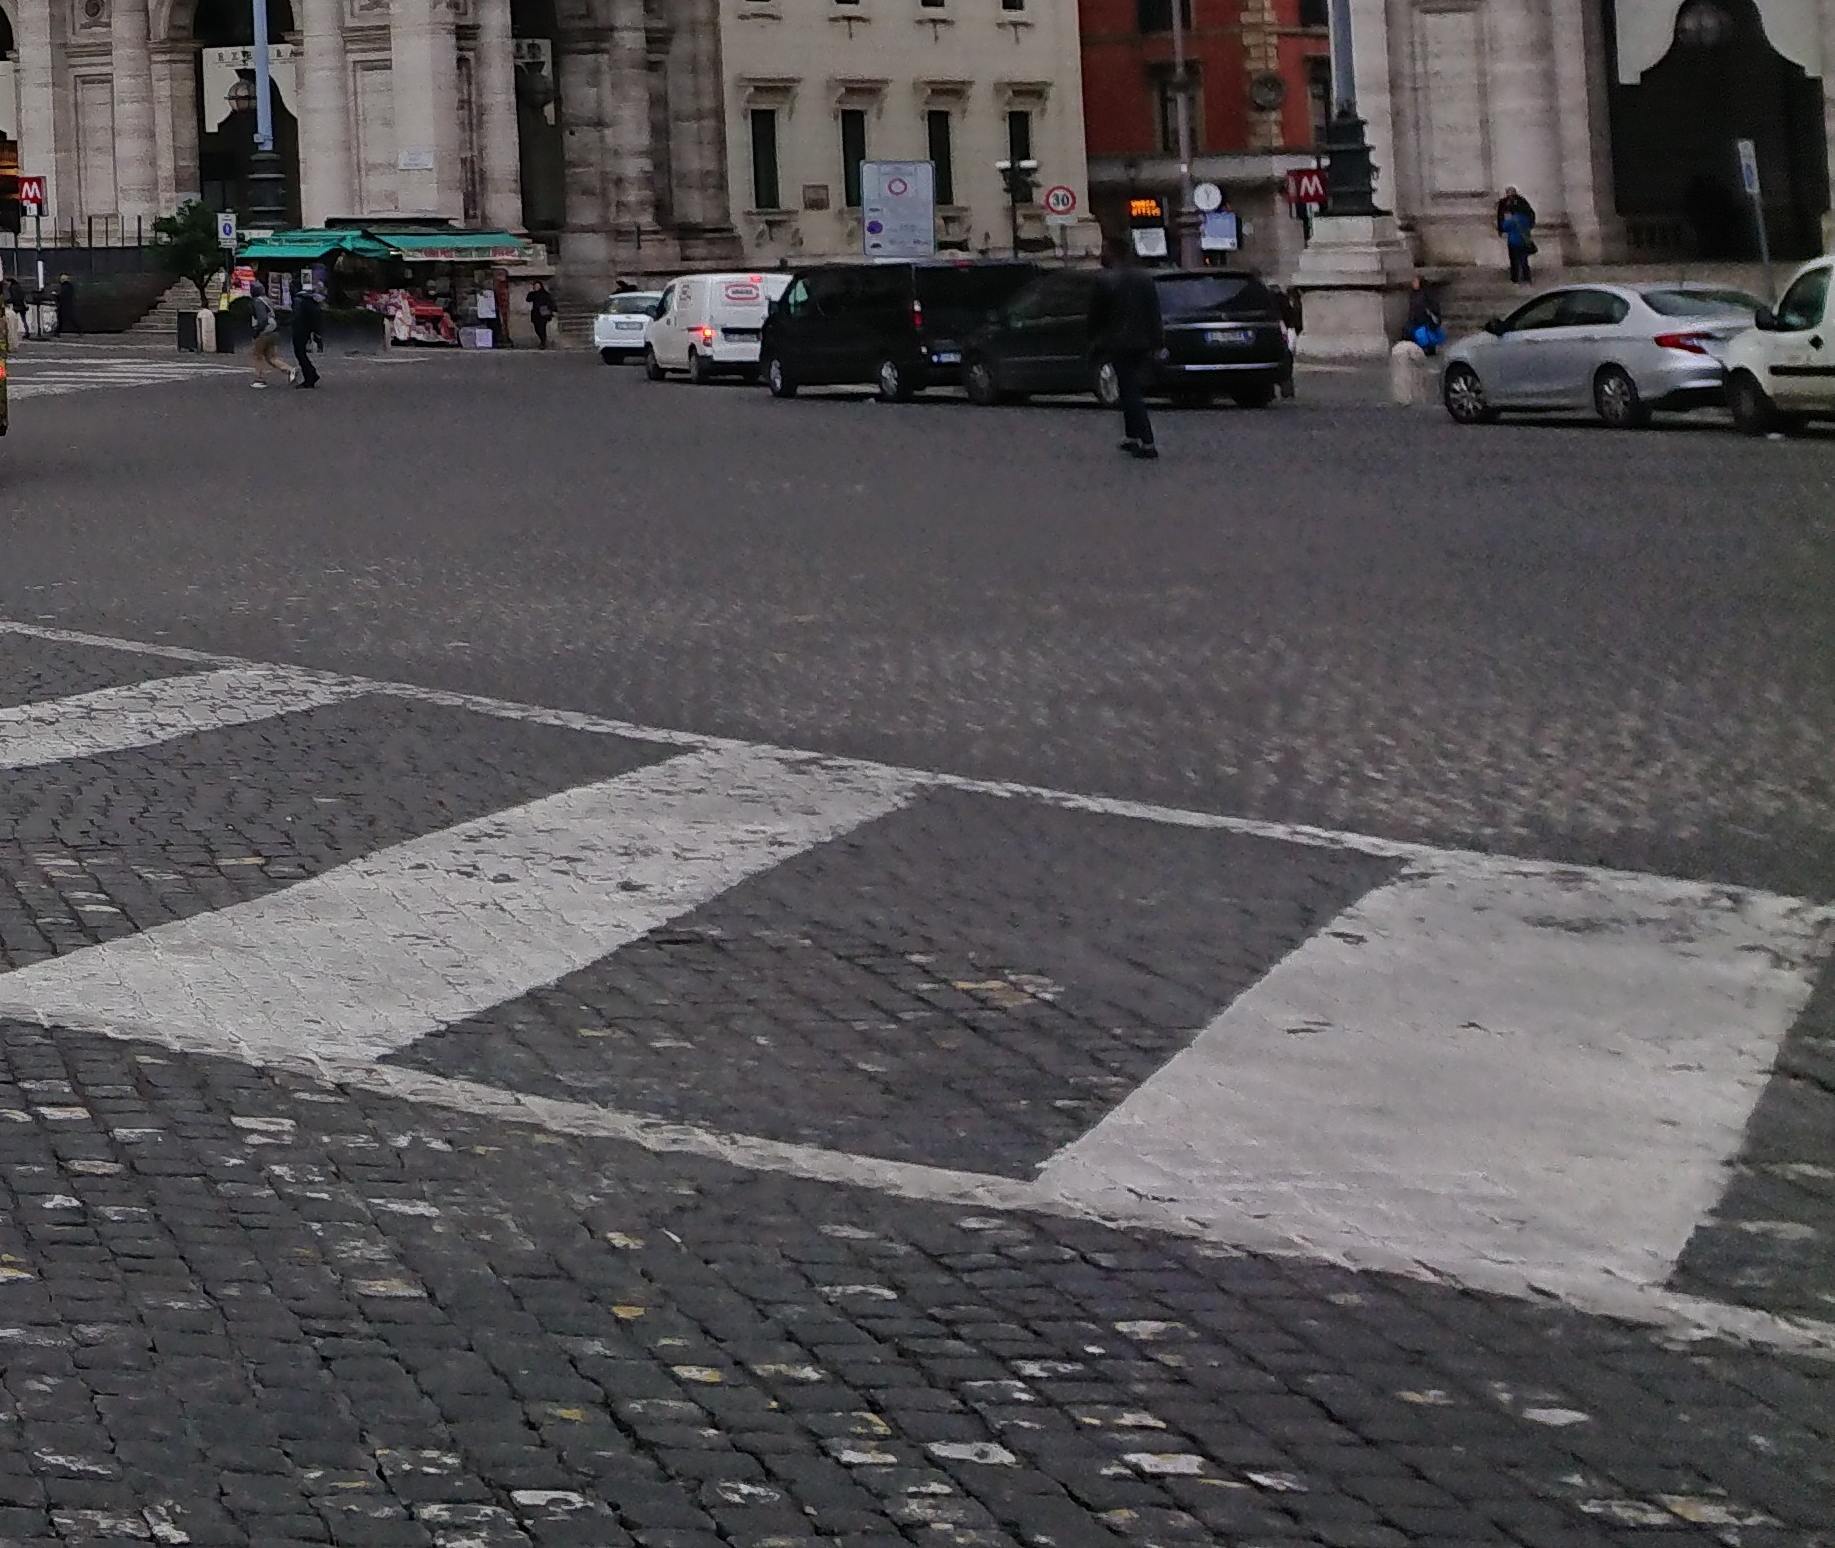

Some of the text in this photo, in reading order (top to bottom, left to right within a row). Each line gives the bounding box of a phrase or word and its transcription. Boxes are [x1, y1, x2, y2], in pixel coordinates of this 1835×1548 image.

[21, 181, 42, 199] M
[1299, 173, 1324, 197] M
[1052, 192, 1070, 207] 30
